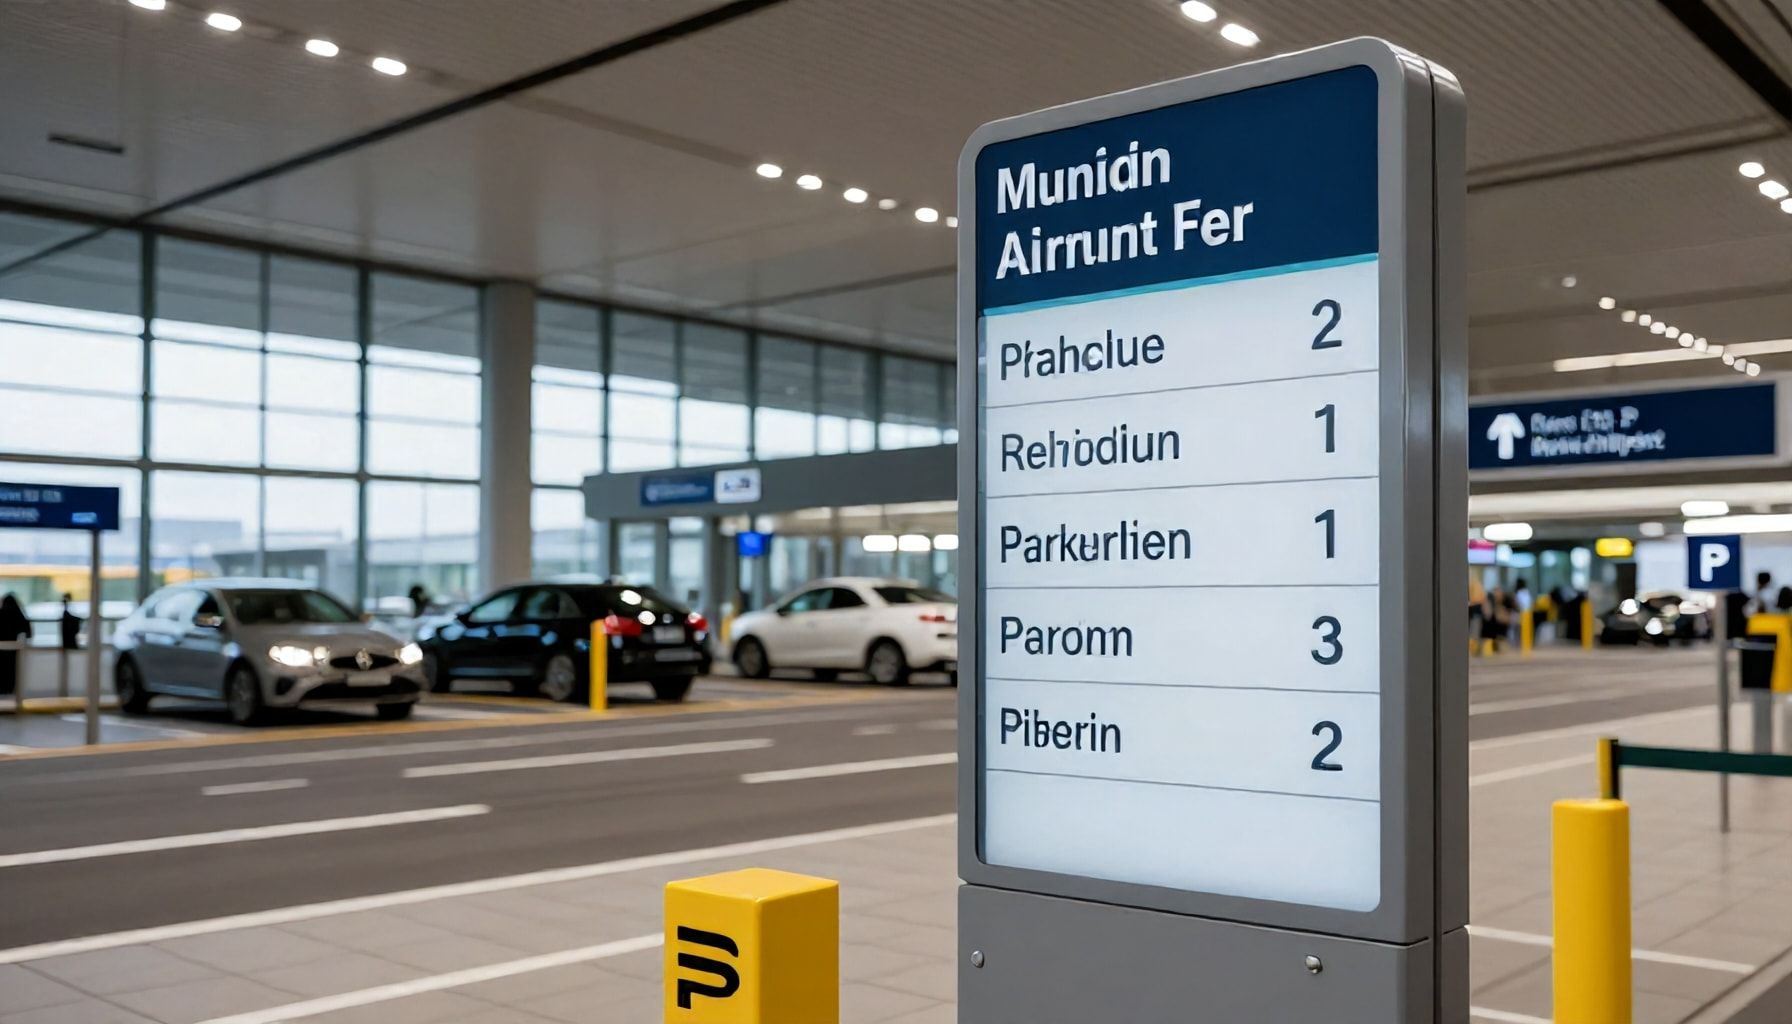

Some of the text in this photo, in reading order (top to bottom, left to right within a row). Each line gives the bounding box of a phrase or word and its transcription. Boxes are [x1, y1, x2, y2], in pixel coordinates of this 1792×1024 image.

[1173, 198, 1254, 251] Fer
[1311, 298, 1343, 351] 2
[1314, 403, 1336, 454] 1
[1314, 509, 1336, 560] 1
[1700, 543, 1730, 582] P
[1310, 615, 1344, 666] 3
[1310, 720, 1344, 772] 2
